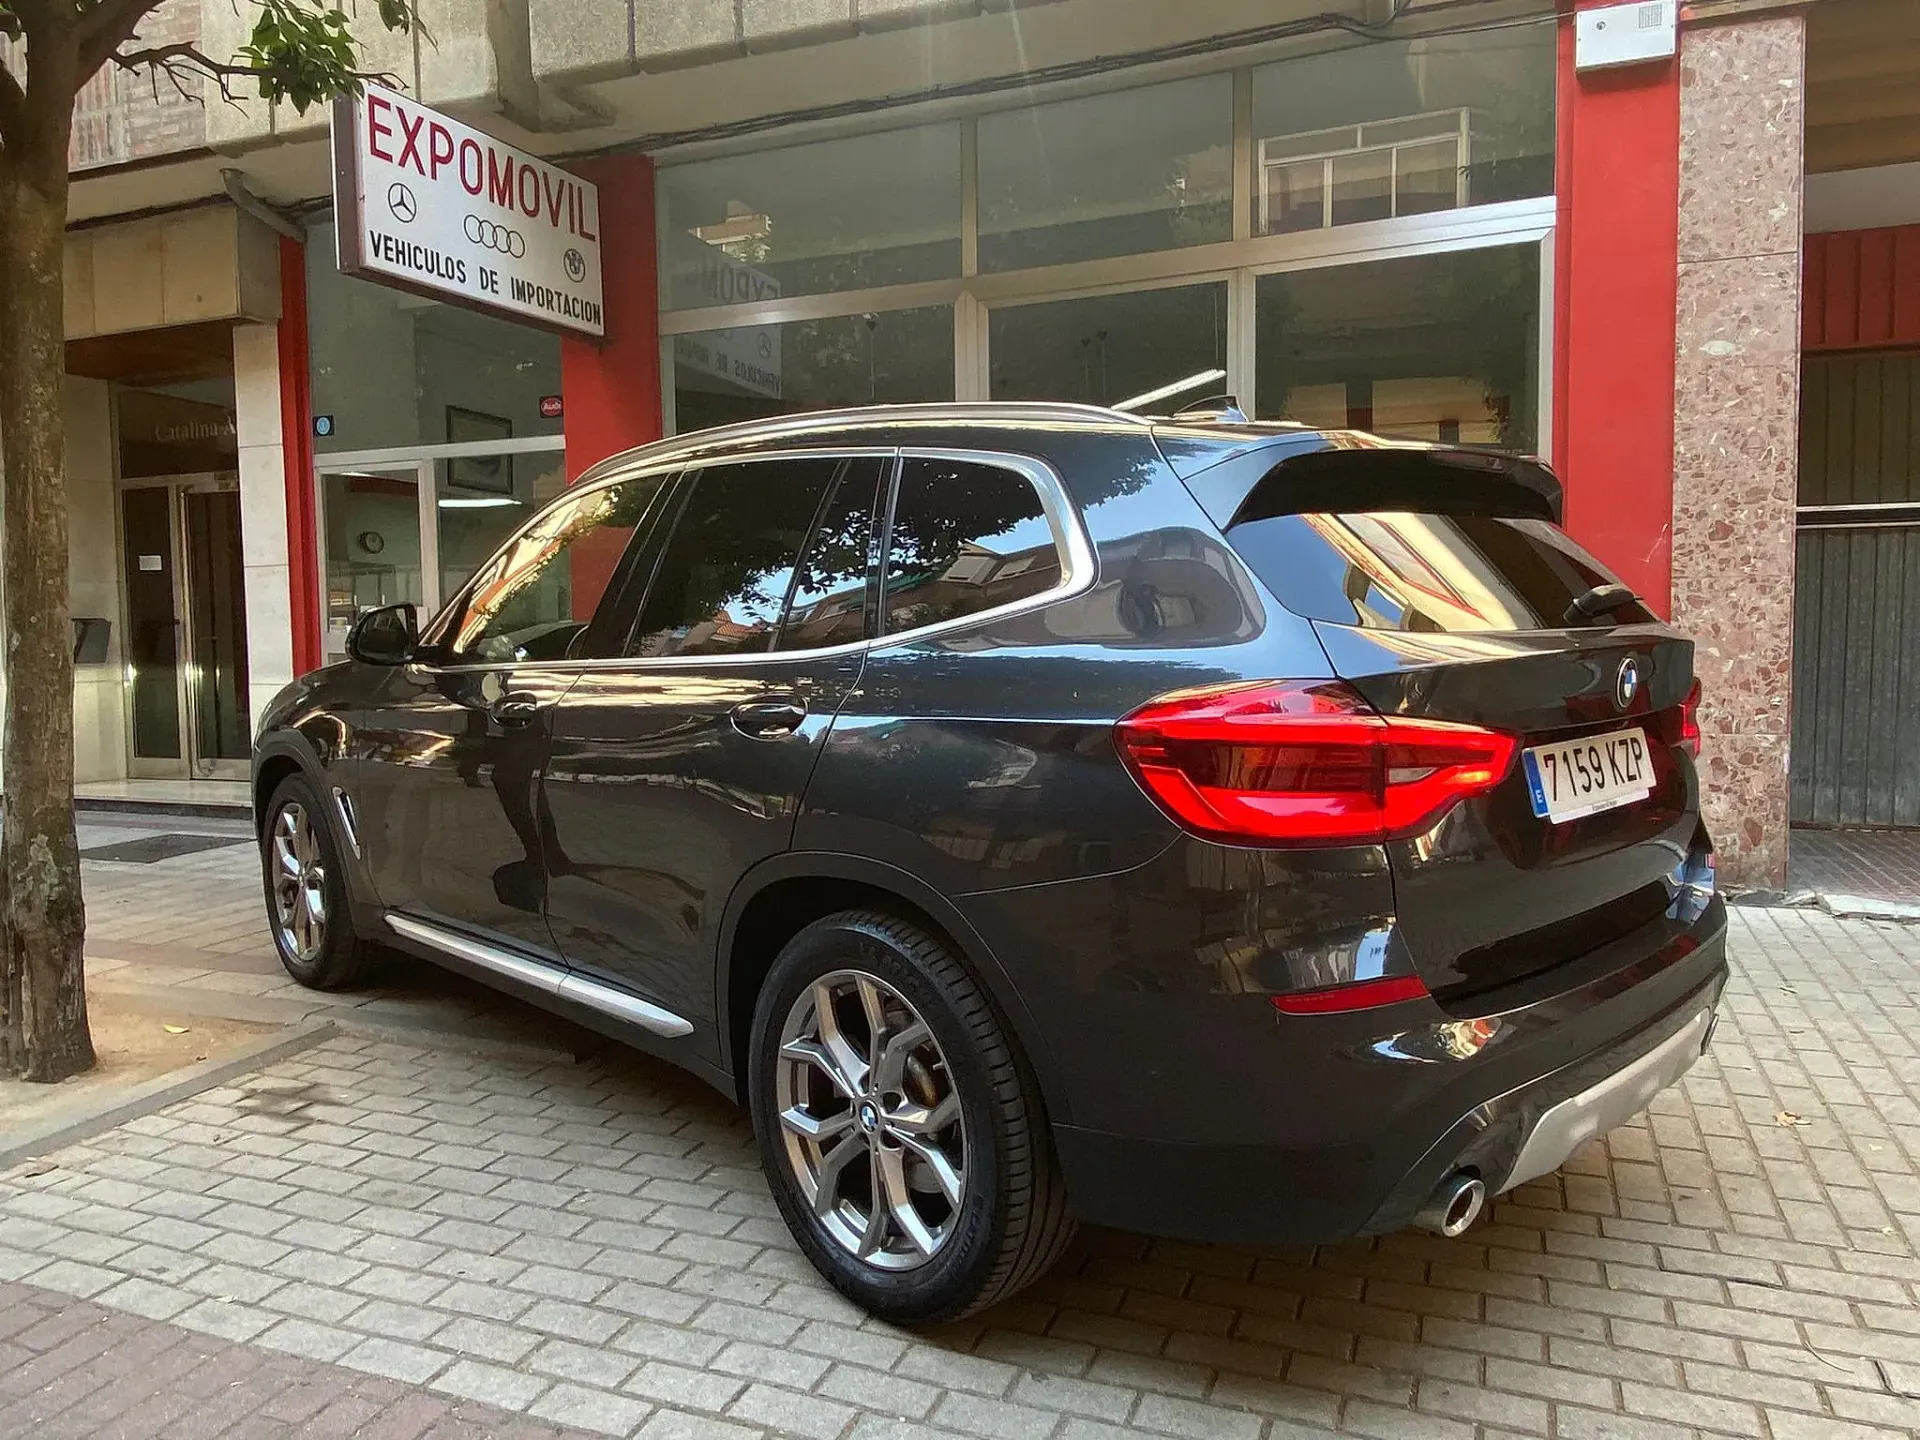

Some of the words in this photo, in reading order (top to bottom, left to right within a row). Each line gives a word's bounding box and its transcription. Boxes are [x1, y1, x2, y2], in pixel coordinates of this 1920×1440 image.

[367, 93, 596, 242] EXPOMOVIL
[370, 230, 467, 284] VEHICULOS
[479, 266, 499, 294] DE
[510, 276, 601, 326] IMPORTACION
[1535, 789, 1544, 803] E
[1543, 745, 1606, 802] 7159
[1605, 736, 1643, 786] KZP
